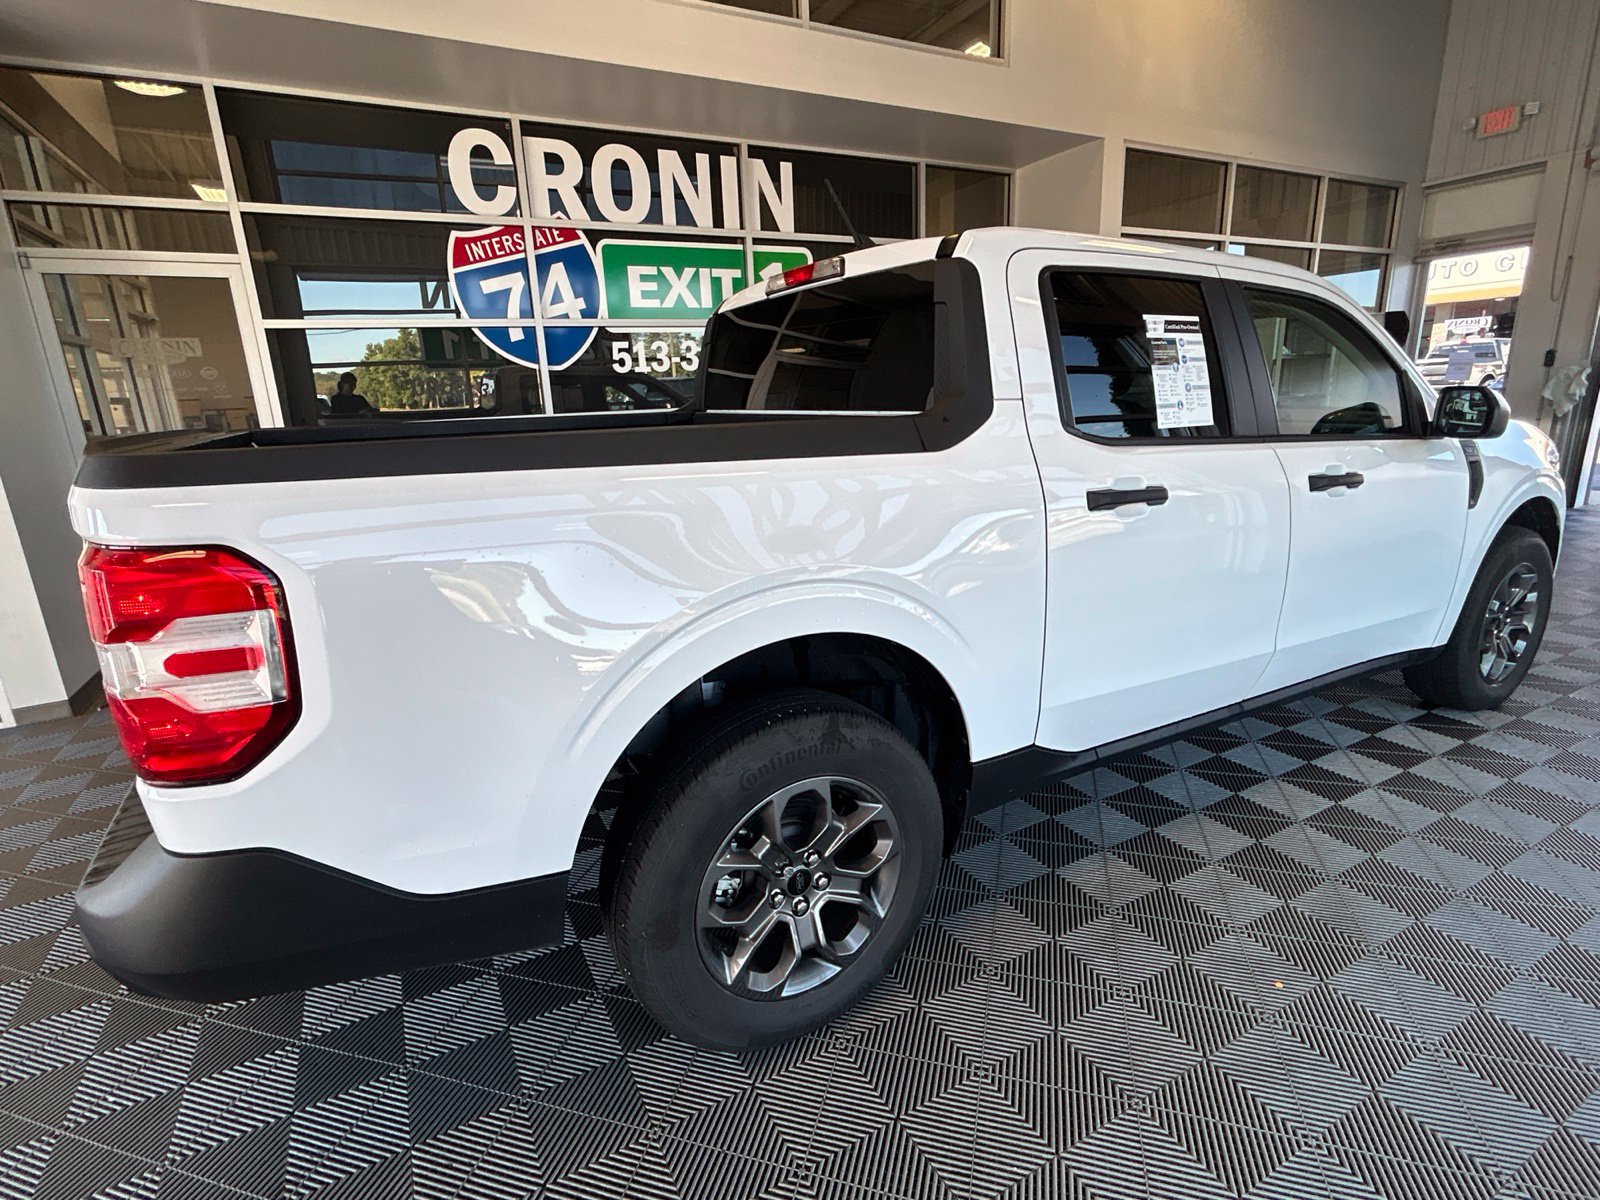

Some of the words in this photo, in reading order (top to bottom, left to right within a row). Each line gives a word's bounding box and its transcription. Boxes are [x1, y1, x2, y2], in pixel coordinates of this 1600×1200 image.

[447, 127, 795, 232] CRONIN
[464, 227, 564, 262] INTERSATE
[479, 262, 587, 343] 74
[626, 265, 742, 309] EXIT
[740, 739, 840, 789] Continental
